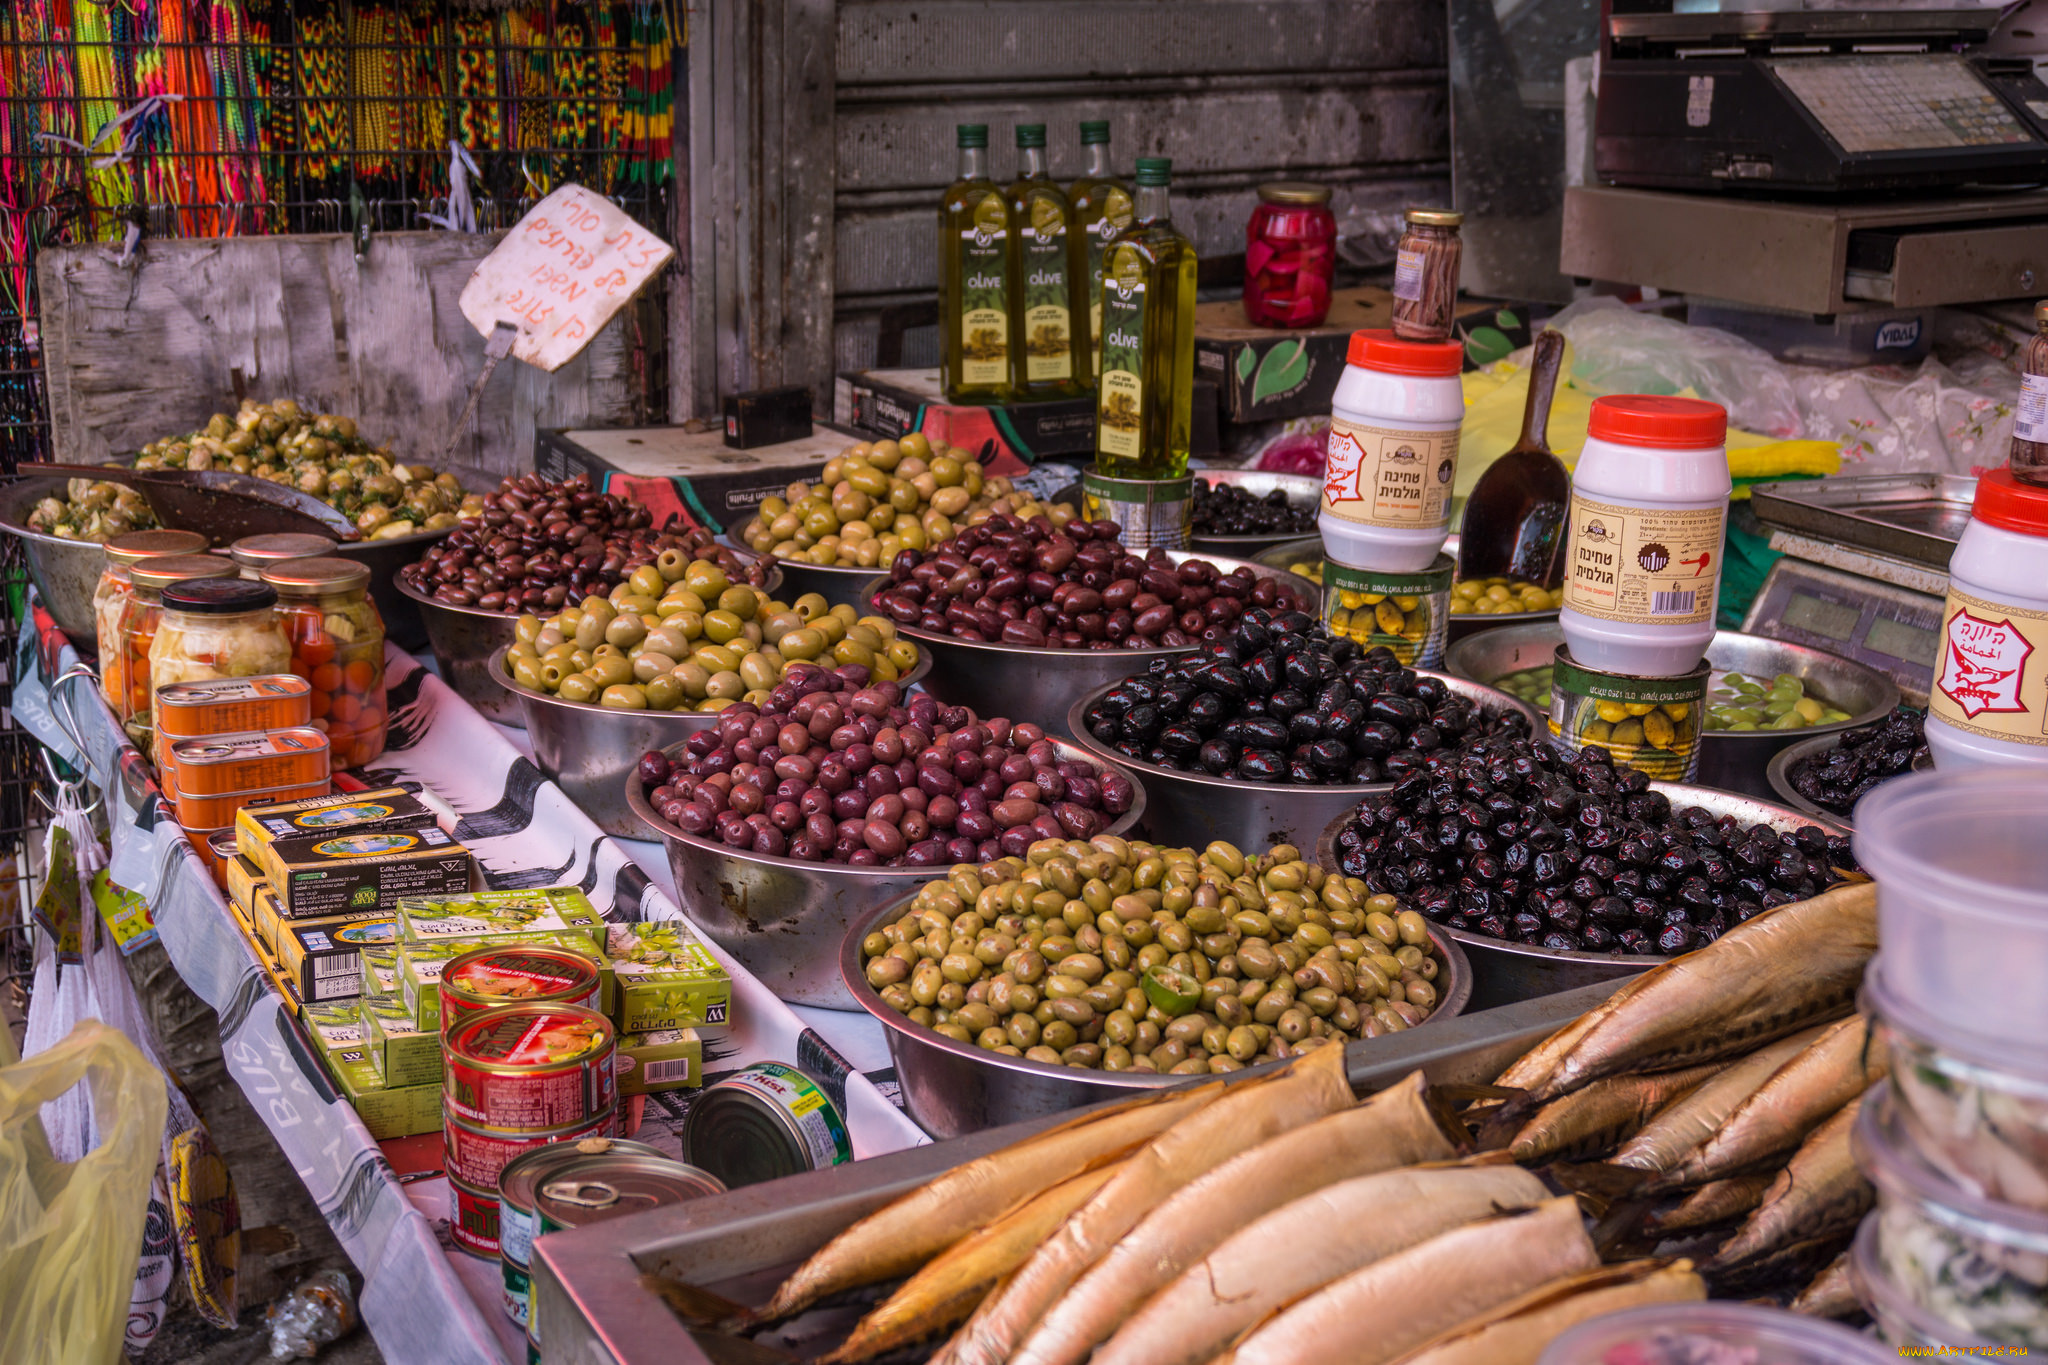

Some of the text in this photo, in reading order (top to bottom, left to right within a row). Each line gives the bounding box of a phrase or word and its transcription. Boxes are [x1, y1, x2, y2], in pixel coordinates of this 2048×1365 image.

[605, 230, 663, 268] זית
[594, 268, 627, 296] של
[552, 314, 586, 339] בן
[1881, 327, 1918, 344] VIDAL
[1379, 486, 1421, 500] גולמית
[1580, 547, 1613, 566] טחינה
[1576, 564, 1614, 584] גולמית
[1960, 622, 2006, 645] היונה
[113, 904, 137, 925] Ball
[422, 925, 487, 934] סרדינים
[631, 1018, 676, 1029] סרדינים
[232, 1041, 302, 1128] BUS
[477, 1237, 499, 1250] CHUNKS
